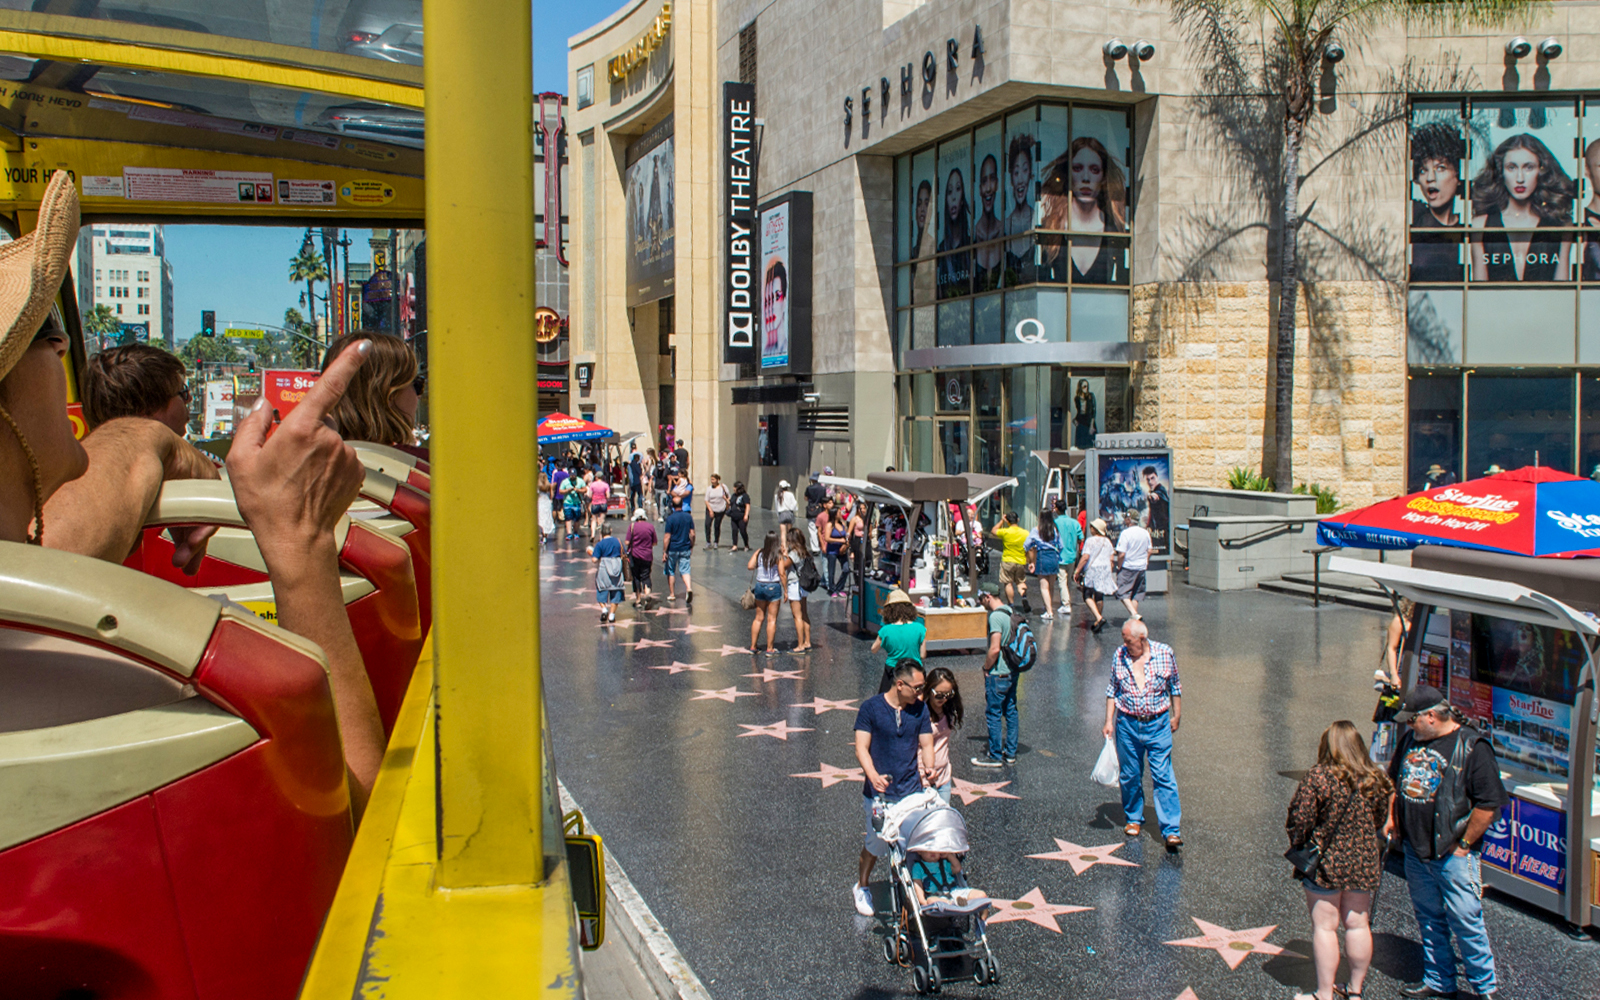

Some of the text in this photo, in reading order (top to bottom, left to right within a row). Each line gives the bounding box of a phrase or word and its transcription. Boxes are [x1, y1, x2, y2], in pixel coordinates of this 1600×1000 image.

[843, 24, 985, 125] SEPHORA
[731, 99, 751, 216] THEATRE
[4, 168, 76, 184] YOUR HED
[731, 221, 751, 308] DOLBY
[1482, 252, 1560, 264] SEPHORA
[1014, 318, 1048, 344] Q
[945, 378, 963, 405] Q
[1092, 438, 1169, 449] DIRECTORY
[1401, 511, 1426, 523] Hop
[1424, 515, 1443, 525] On
[1441, 517, 1467, 529] Hop
[1508, 819, 1568, 855] TOURS
[1481, 841, 1518, 865] TARTS
